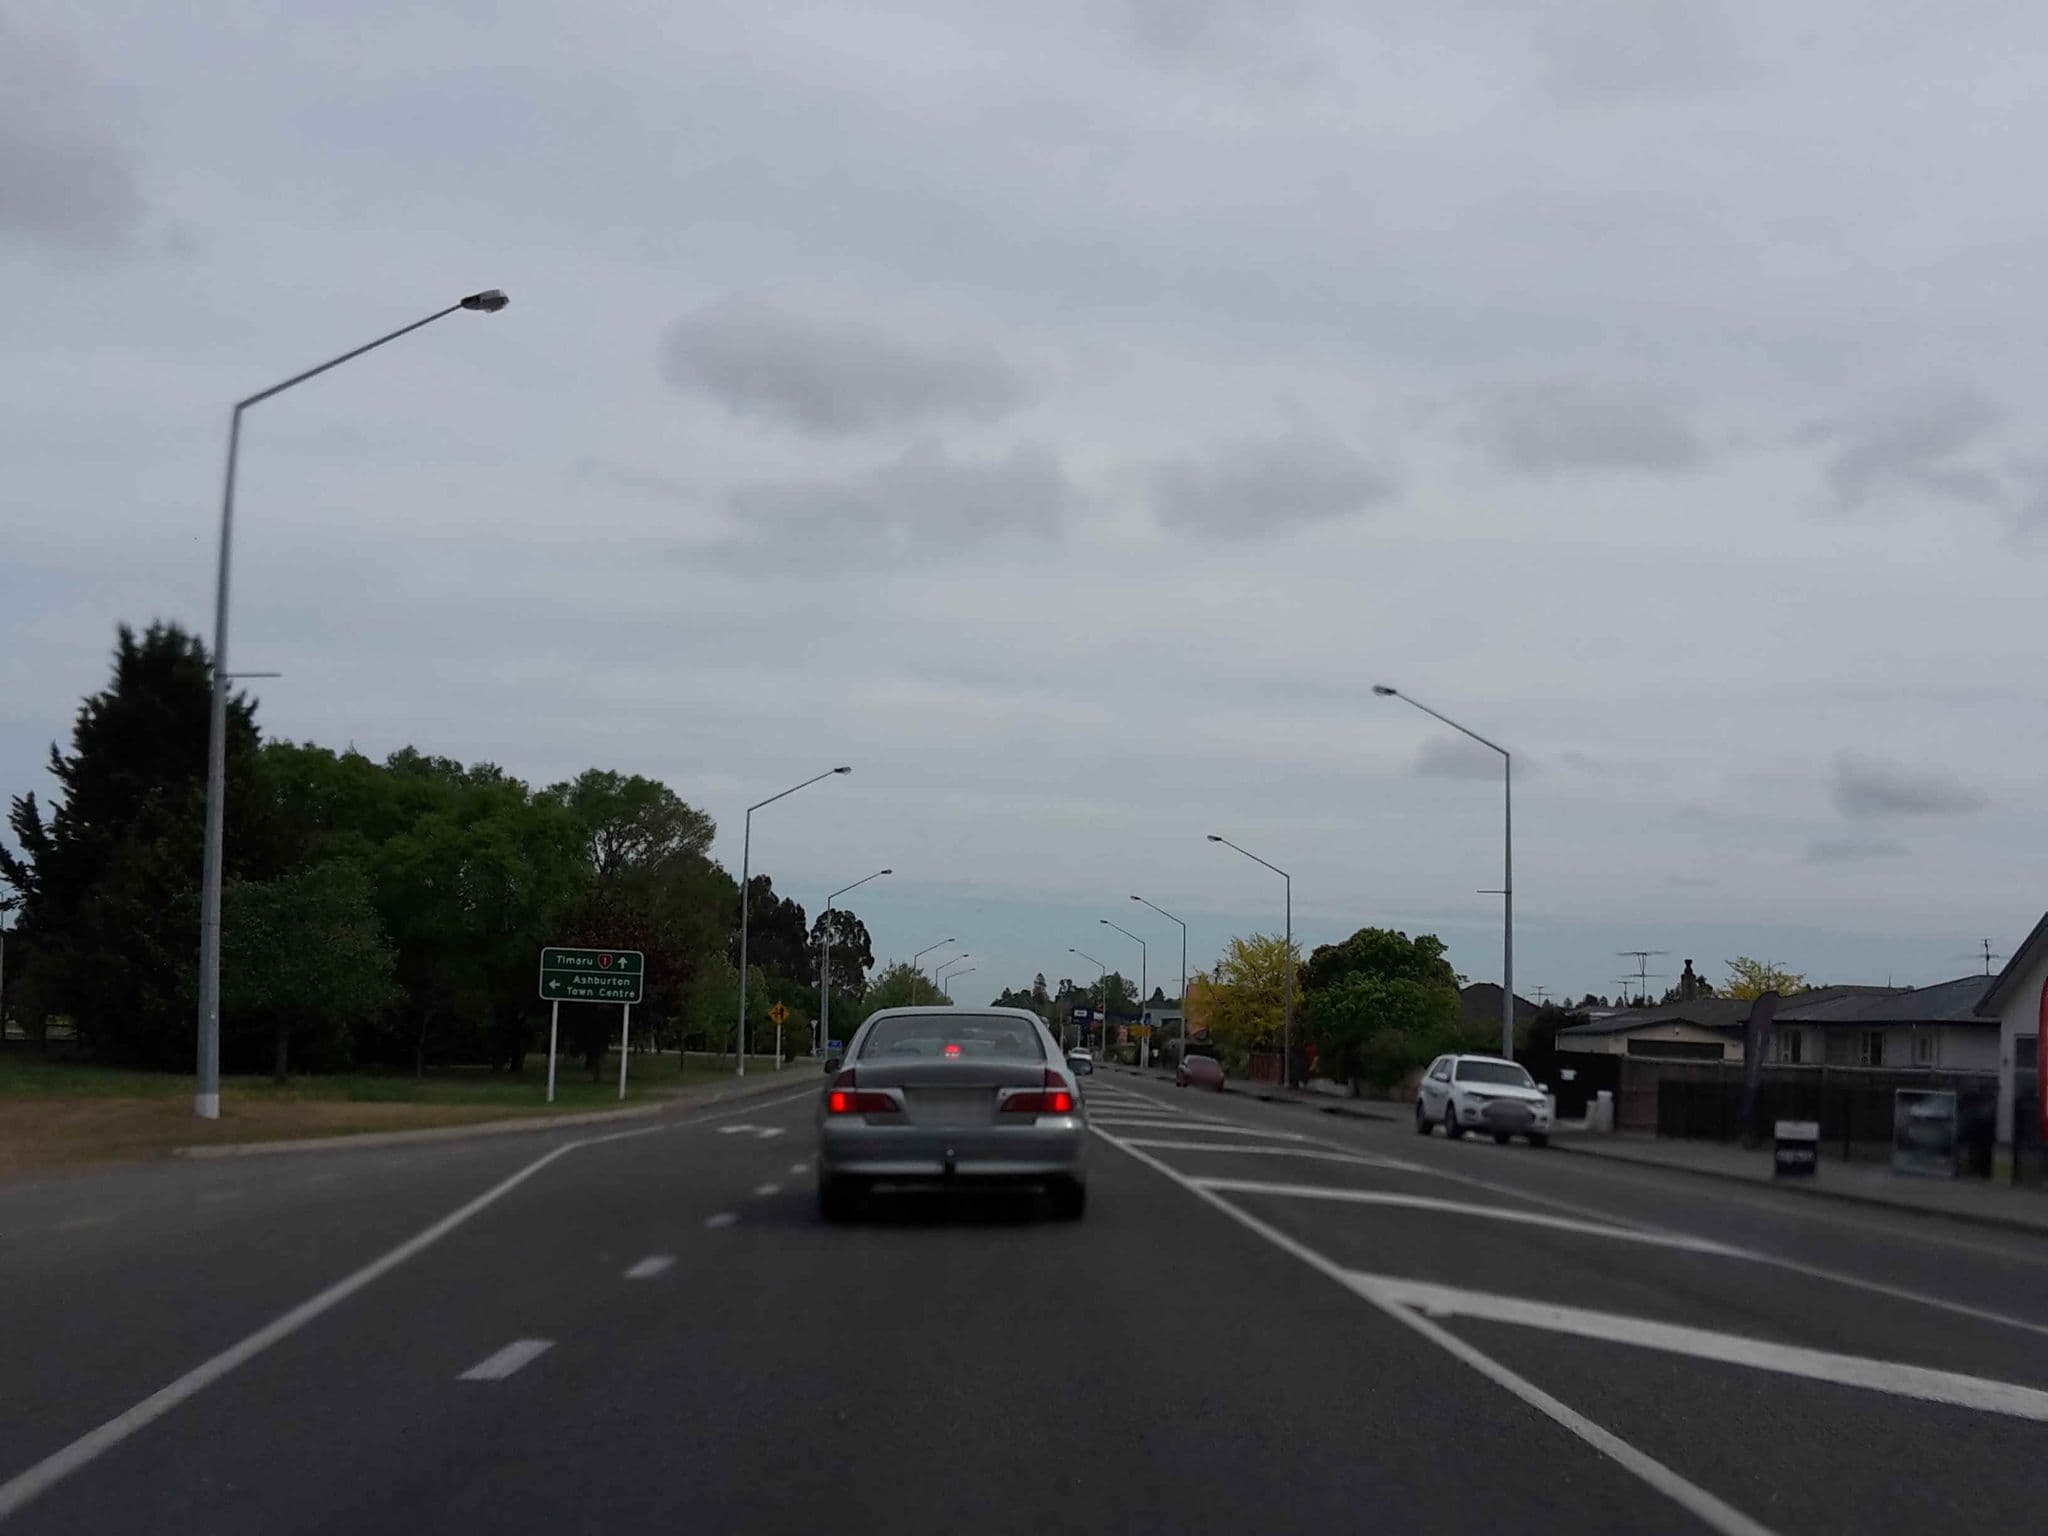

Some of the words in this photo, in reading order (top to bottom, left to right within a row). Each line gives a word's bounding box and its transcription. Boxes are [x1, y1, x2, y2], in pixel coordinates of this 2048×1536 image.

[556, 955, 593, 966] Timaru
[573, 975, 630, 986] Ashburton
[567, 986, 594, 996] Town
[599, 988, 635, 998] Centre
